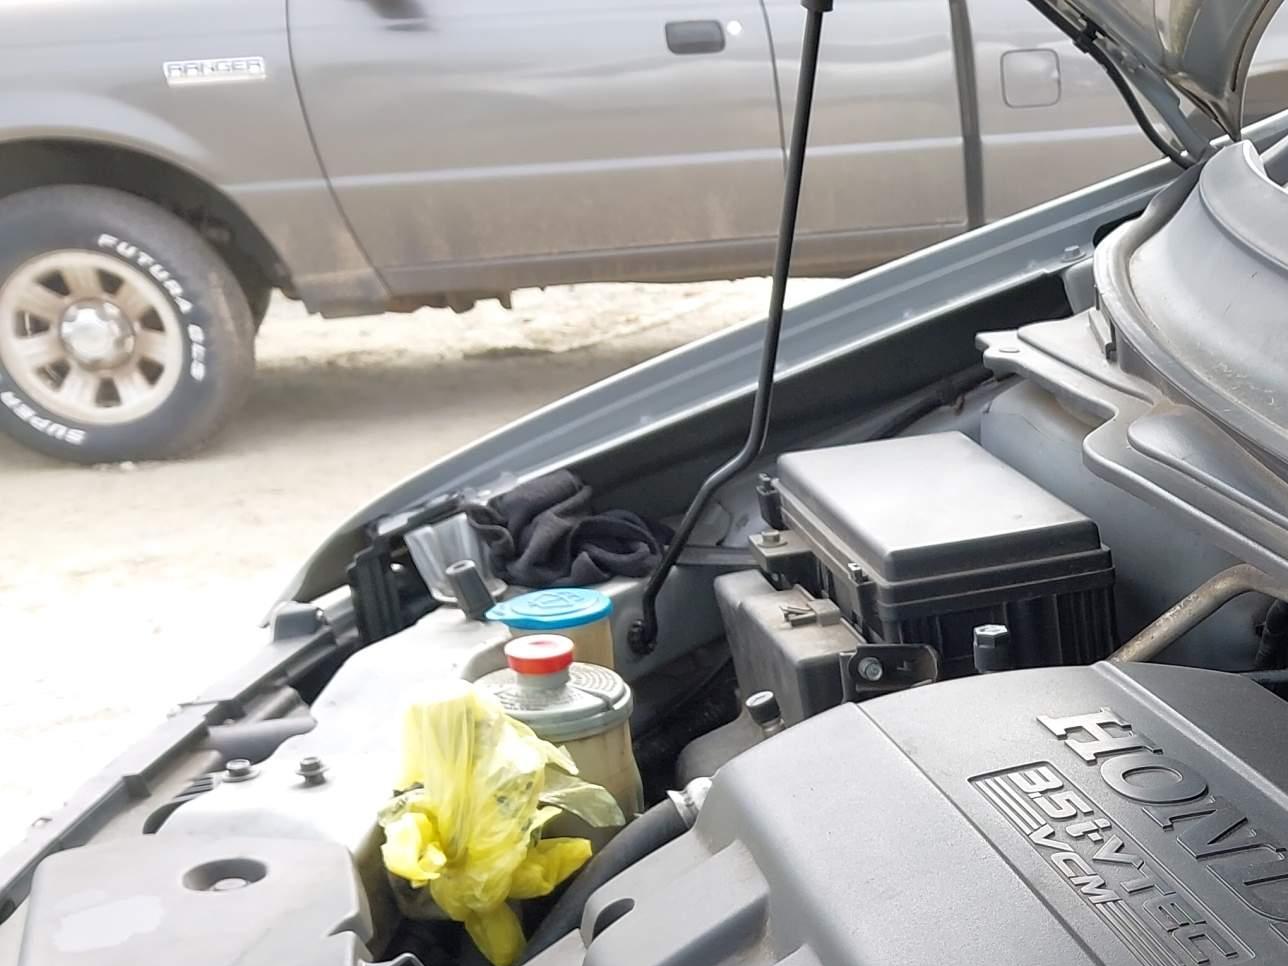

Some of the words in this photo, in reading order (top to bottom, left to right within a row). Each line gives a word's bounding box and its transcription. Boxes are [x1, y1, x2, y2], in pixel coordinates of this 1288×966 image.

[167, 60, 263, 79] RANGER
[98, 233, 193, 314] FUTURA
[0, 391, 86, 445] SUPER
[1028, 822, 1124, 905] VCM
